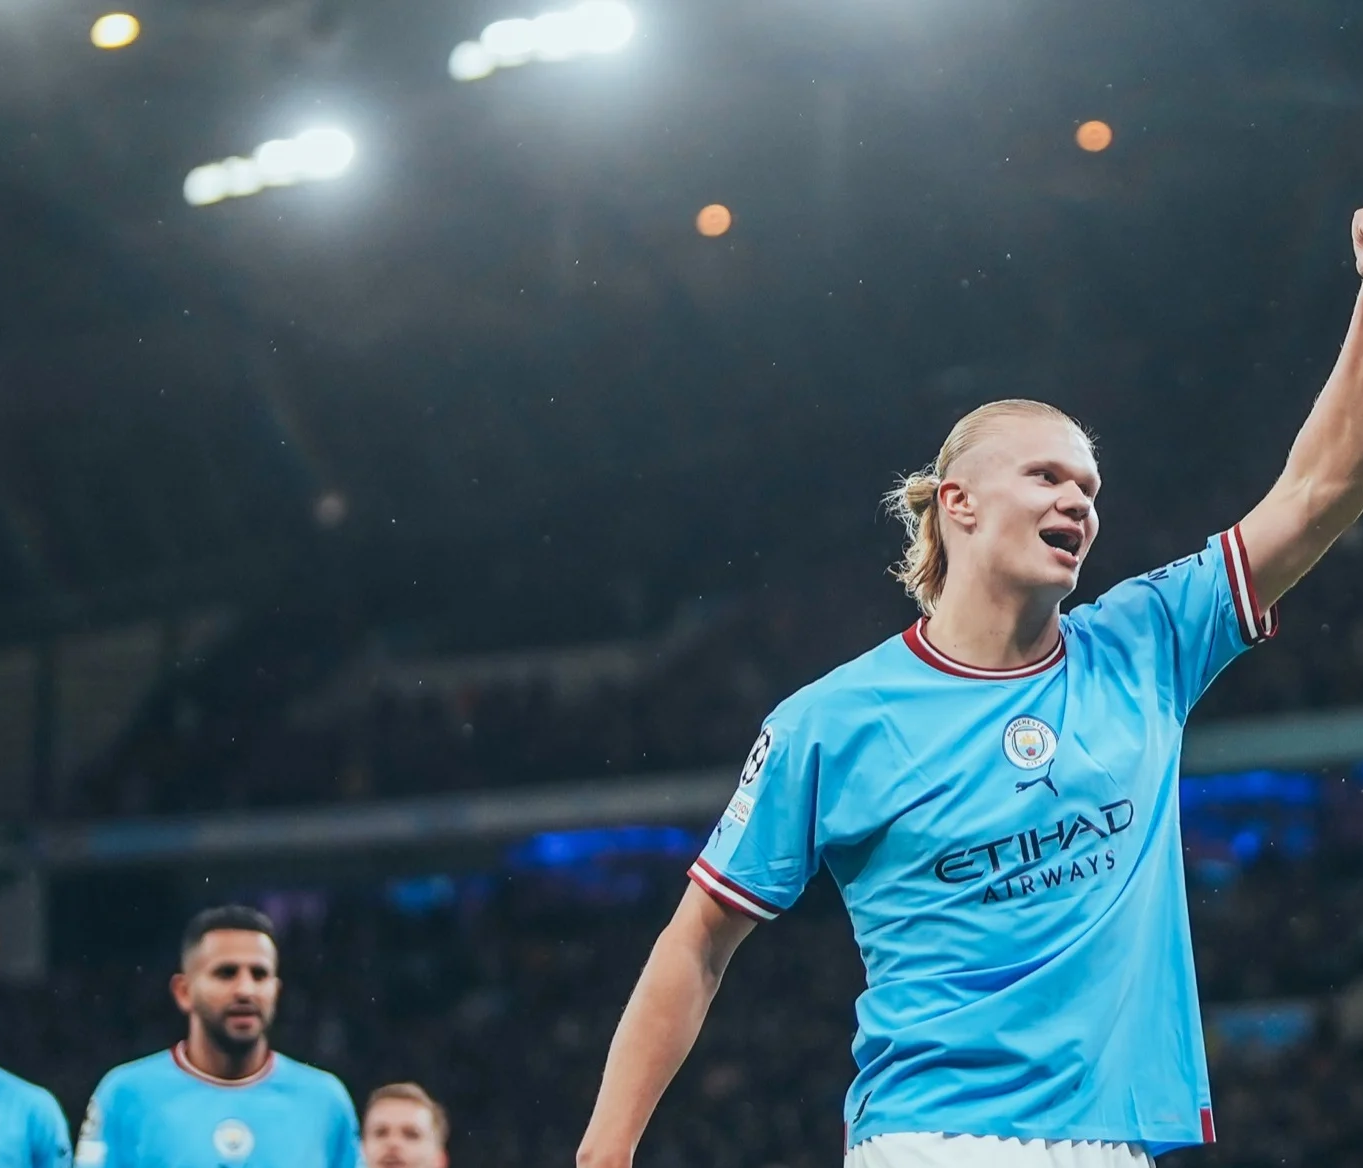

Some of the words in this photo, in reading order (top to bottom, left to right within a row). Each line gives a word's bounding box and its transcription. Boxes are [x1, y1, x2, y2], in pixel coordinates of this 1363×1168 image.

[1007, 719, 1049, 737] MANCHESTER
[934, 799, 1134, 884] ETIHAD
[982, 849, 1116, 905] AIRWAYS
